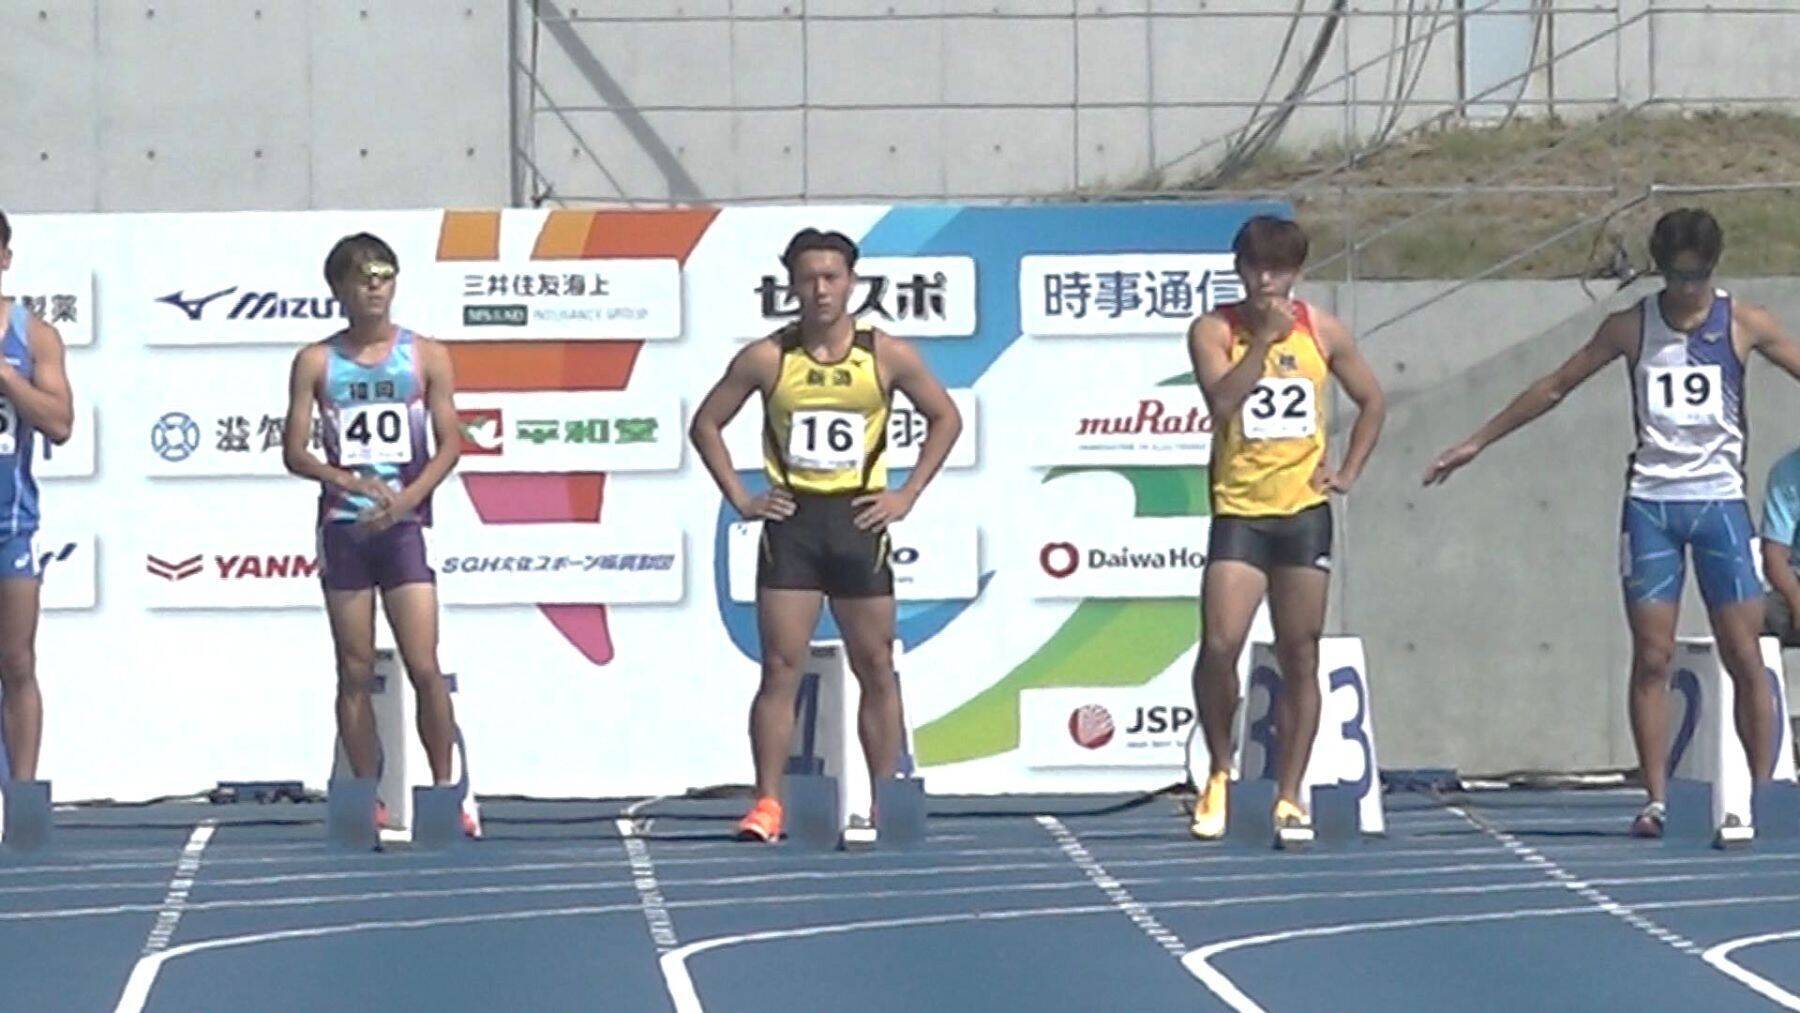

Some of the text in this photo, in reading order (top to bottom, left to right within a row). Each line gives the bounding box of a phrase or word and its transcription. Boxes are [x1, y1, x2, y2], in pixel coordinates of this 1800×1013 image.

[464, 273, 610, 297] 三井住友海上
[754, 272, 948, 321] セスポ
[1044, 270, 1244, 318] 時事通信
[1250, 385, 1307, 418] 32
[1657, 372, 1711, 407] 19
[346, 410, 401, 444] 40
[517, 418, 658, 443] 平和堂
[802, 416, 853, 451] 16
[1088, 546, 1165, 568] Daiwa
[1329, 665, 1372, 800] 3
